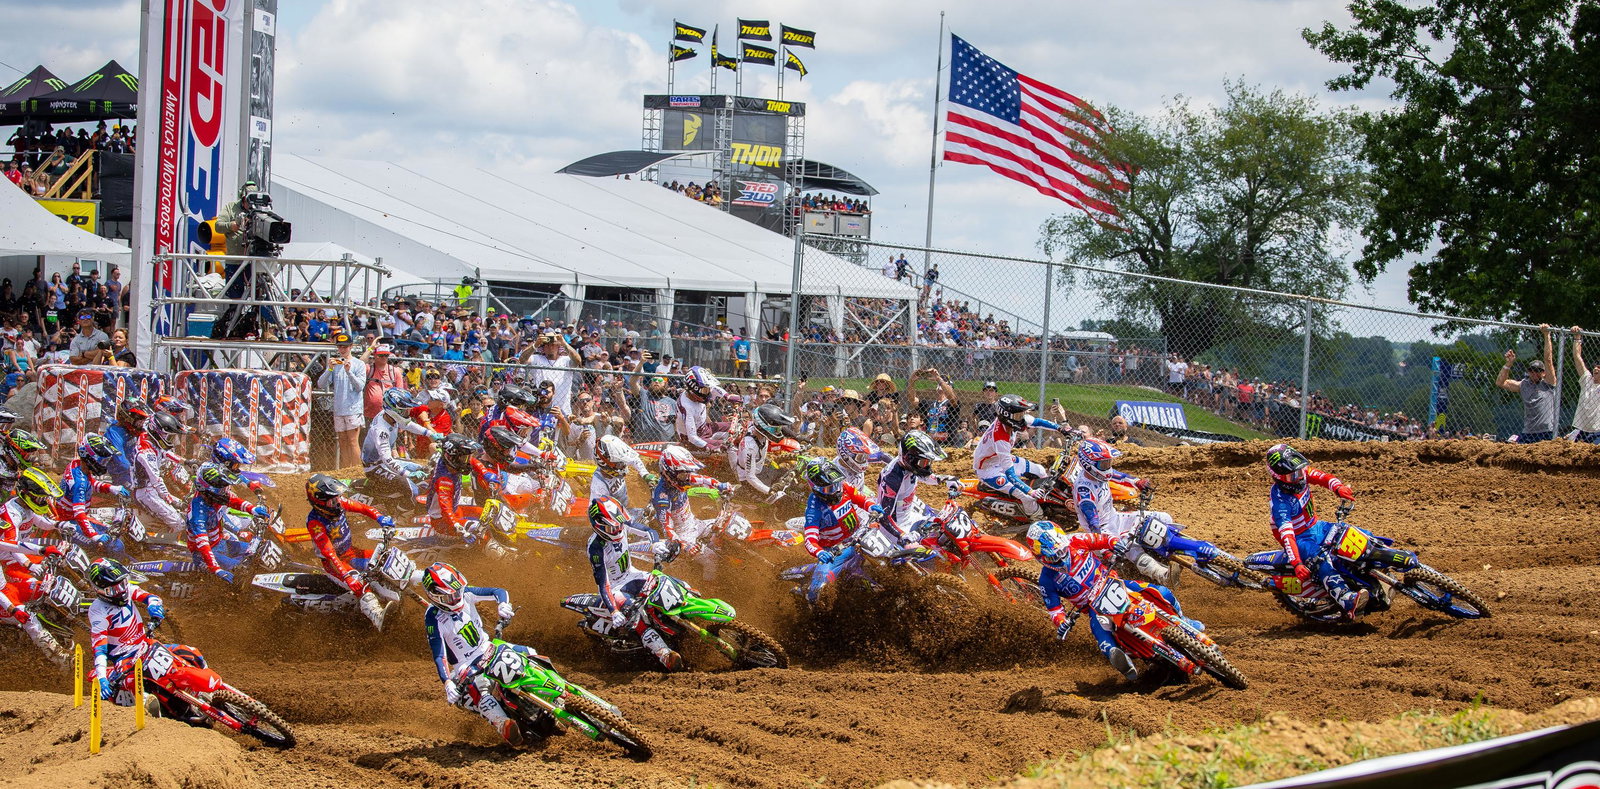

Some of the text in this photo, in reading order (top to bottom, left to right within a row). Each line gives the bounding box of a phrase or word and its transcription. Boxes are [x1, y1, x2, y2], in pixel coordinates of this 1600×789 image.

[741, 25, 770, 36] THOR
[783, 32, 812, 44] THOR
[744, 48, 774, 59] THOR
[189, 0, 226, 147] ED
[766, 100, 790, 112] THOR
[730, 142, 782, 168] THOR
[158, 89, 178, 278] AMERICA'S MOTOCROSS TCK
[745, 182, 778, 193] RED
[740, 192, 775, 202] BUD
[1132, 406, 1188, 430] YAMAHA
[990, 500, 1016, 514] 435
[946, 510, 972, 539] 30
[1142, 518, 1168, 548] 99
[866, 529, 891, 555] 31
[1340, 526, 1368, 560] 38
[74, 546, 90, 571] 17
[660, 579, 682, 610] 47
[1282, 577, 1302, 594] 38
[1401, 588, 1428, 604] DUNLOP
[1100, 582, 1127, 614] 16
[108, 600, 133, 630] FLY
[592, 618, 612, 635] 47
[148, 646, 174, 680] 48
[493, 648, 522, 684] 29
[116, 690, 136, 707] 48
[206, 710, 233, 726] DUNLOP
